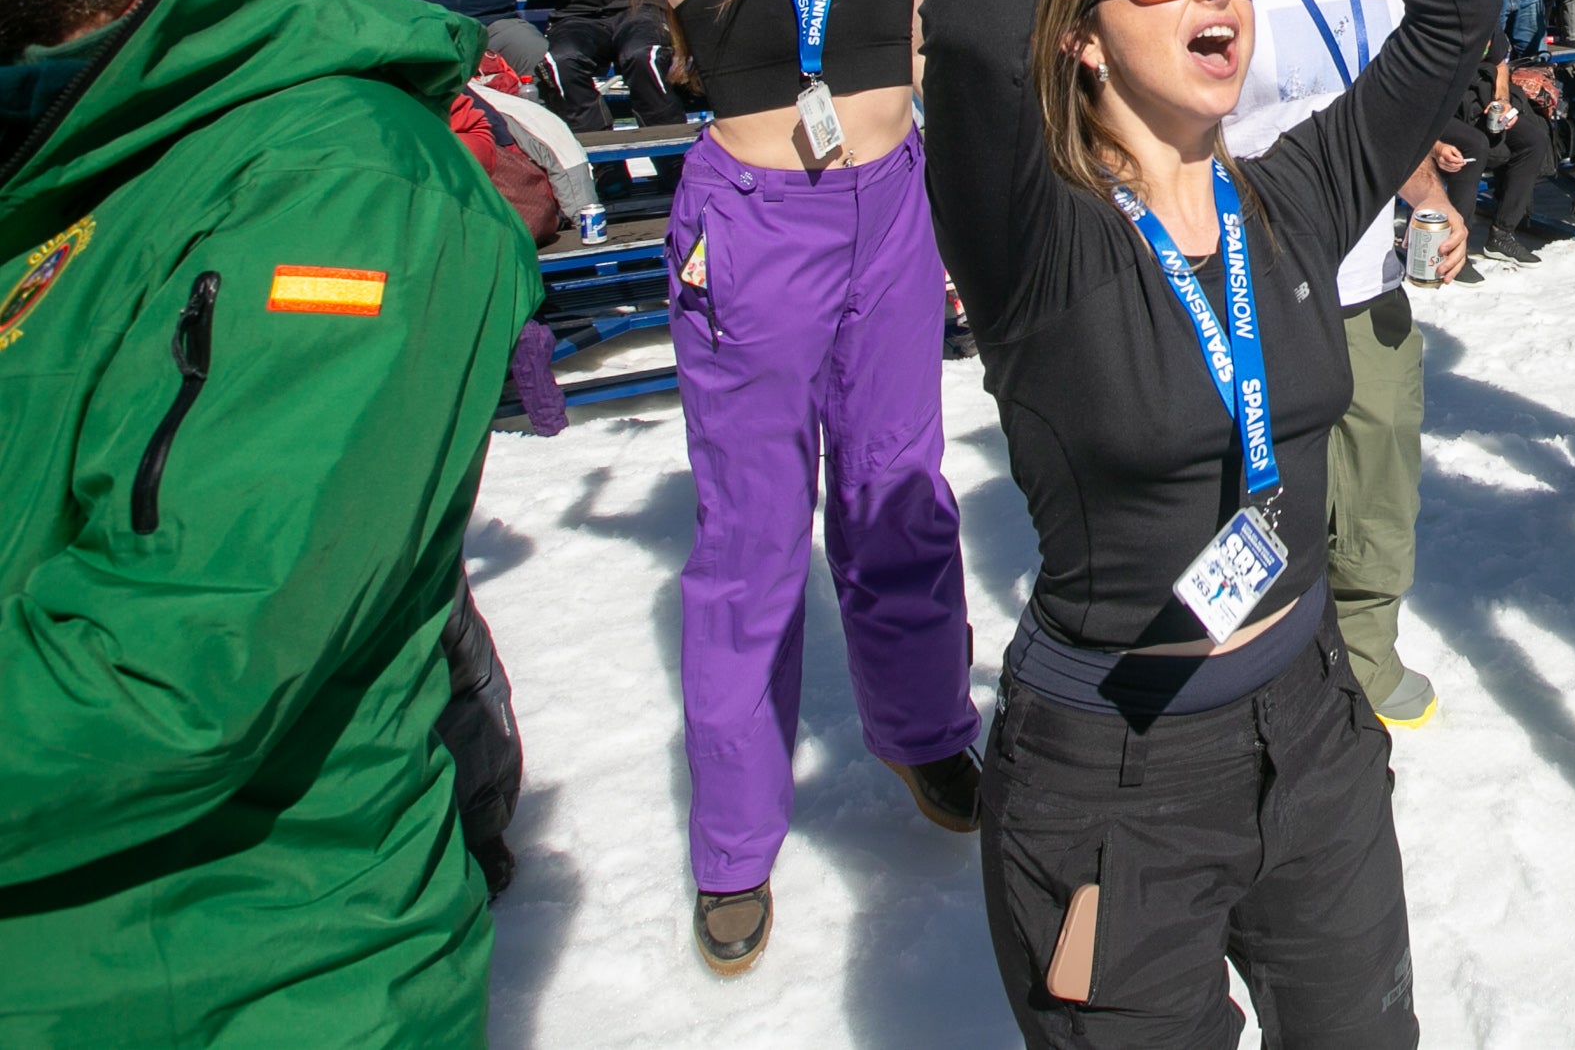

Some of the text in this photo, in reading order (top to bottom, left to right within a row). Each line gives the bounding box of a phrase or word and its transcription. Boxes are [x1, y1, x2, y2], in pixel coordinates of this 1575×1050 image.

[1162, 250, 1234, 383] SPAINSNOW
[1223, 212, 1254, 339] SPAINSNOW
[1191, 573, 1211, 598] 263
